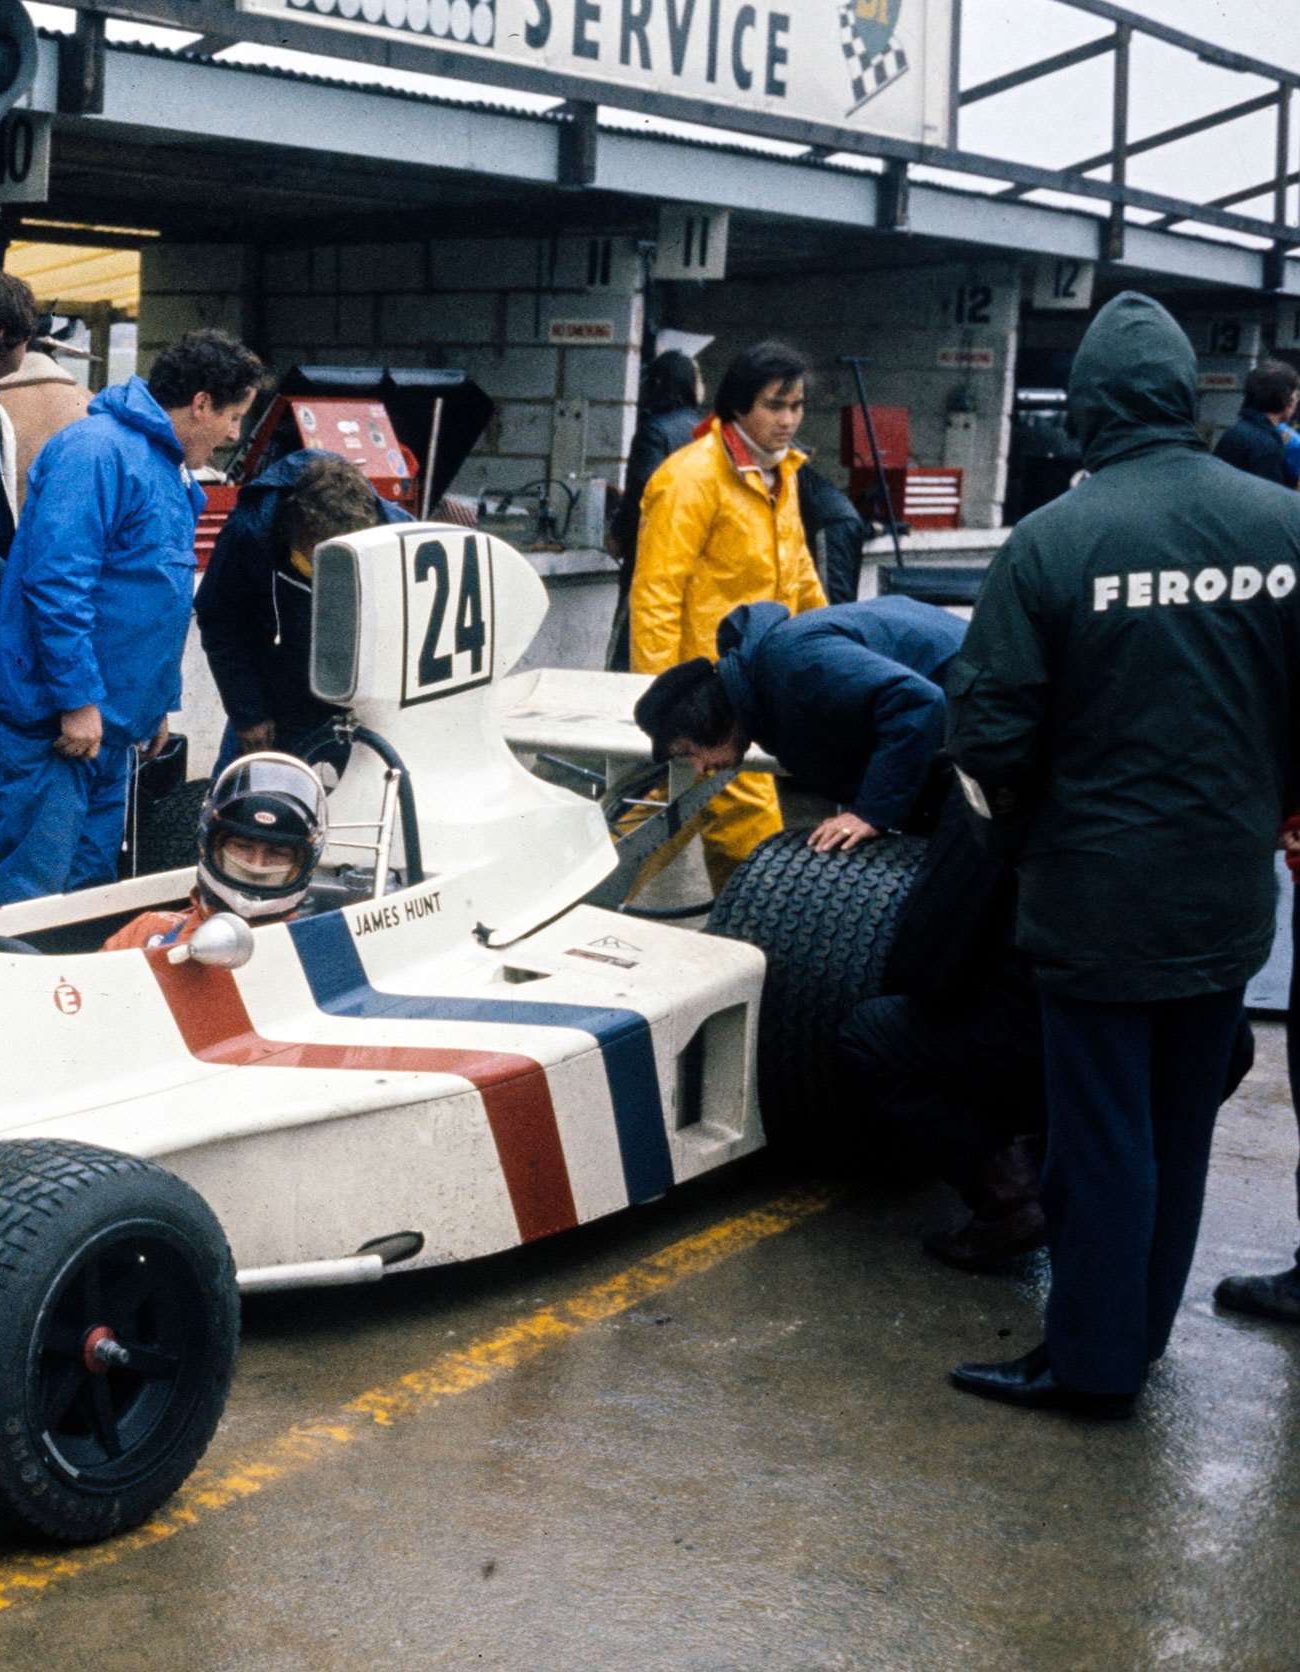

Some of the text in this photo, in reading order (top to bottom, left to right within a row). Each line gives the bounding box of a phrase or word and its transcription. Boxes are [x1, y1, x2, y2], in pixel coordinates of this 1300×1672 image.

[525, 0, 790, 98] SERVICE
[683, 215, 710, 268] 11
[1053, 260, 1080, 298] 12
[956, 285, 993, 323] 12
[413, 534, 486, 688] 24
[1093, 563, 1297, 612] FERODO
[355, 891, 441, 937] JAMES HUNT
